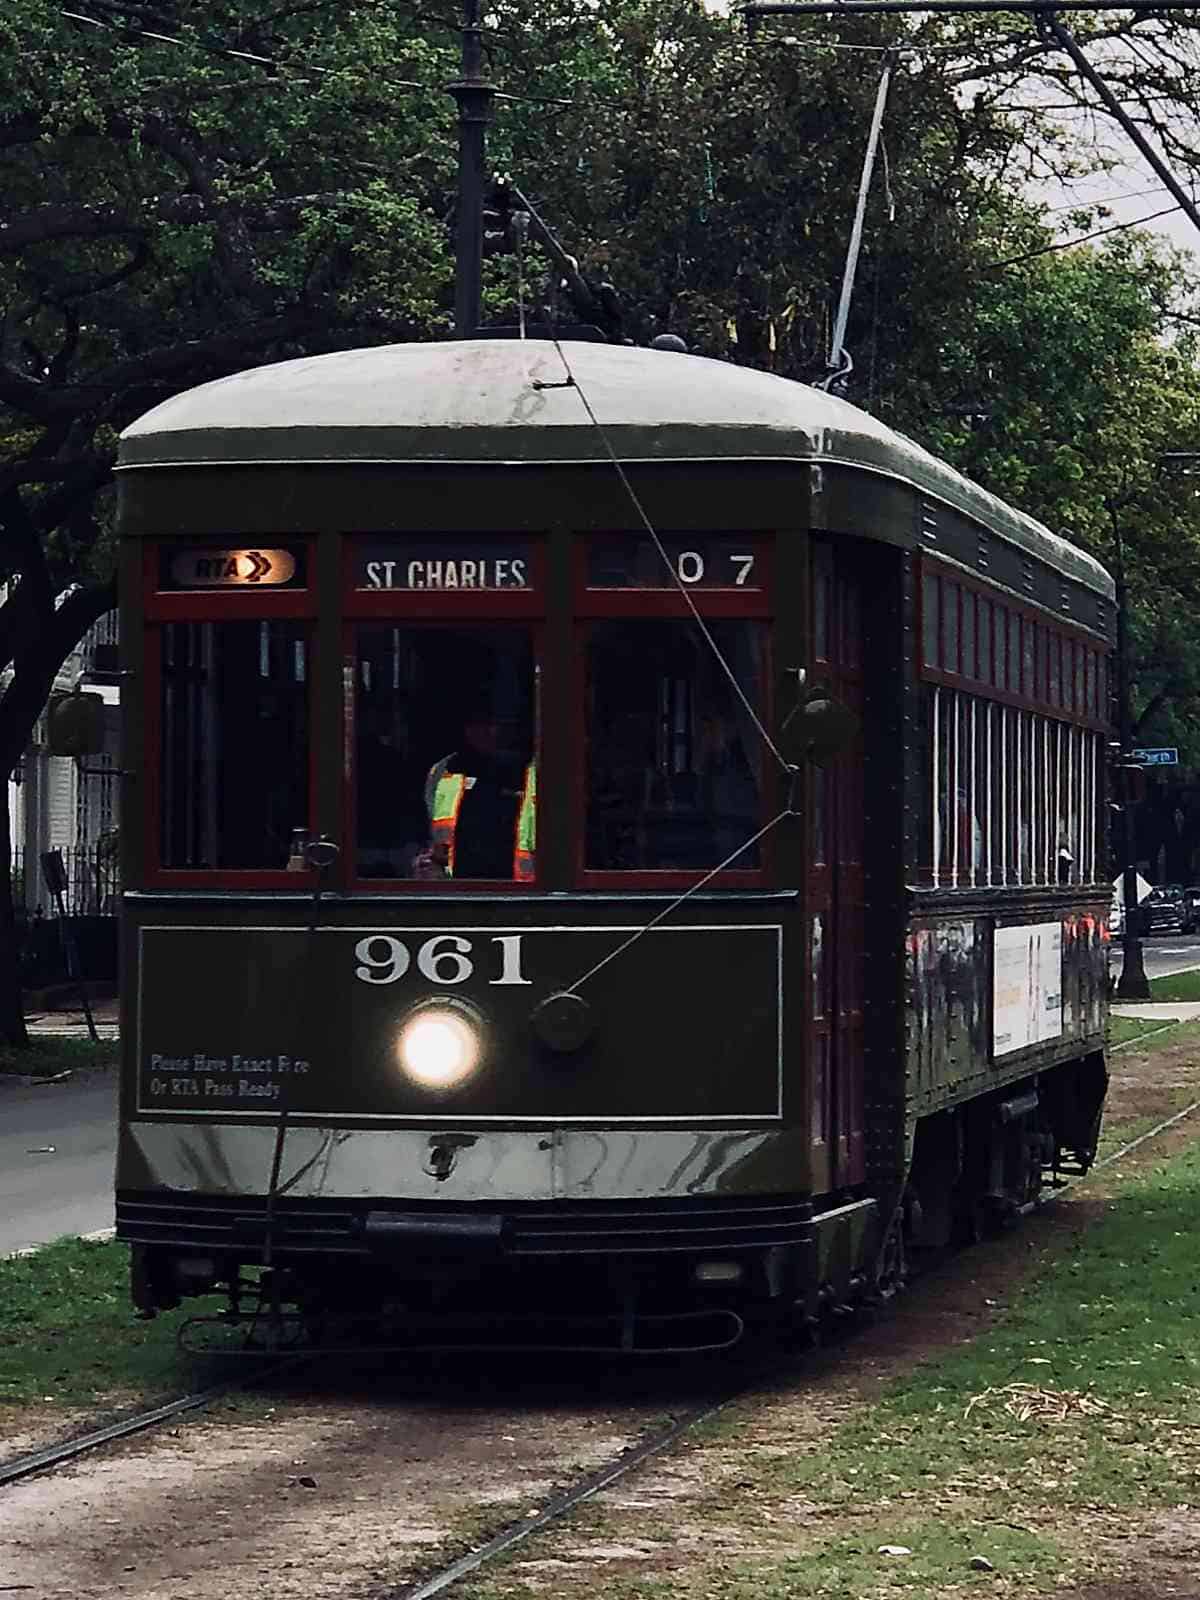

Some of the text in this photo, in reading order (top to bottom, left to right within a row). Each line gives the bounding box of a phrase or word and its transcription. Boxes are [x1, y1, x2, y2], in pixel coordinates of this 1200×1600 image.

[197, 558, 239, 578] RTA
[365, 559, 528, 589] ST CHARLES
[352, 934, 534, 985] 961
[151, 1053, 191, 1071] Please
[194, 1053, 227, 1071] Have
[231, 1053, 271, 1071] Exact
[150, 1077, 281, 1101] Or RTA Pass Ready
